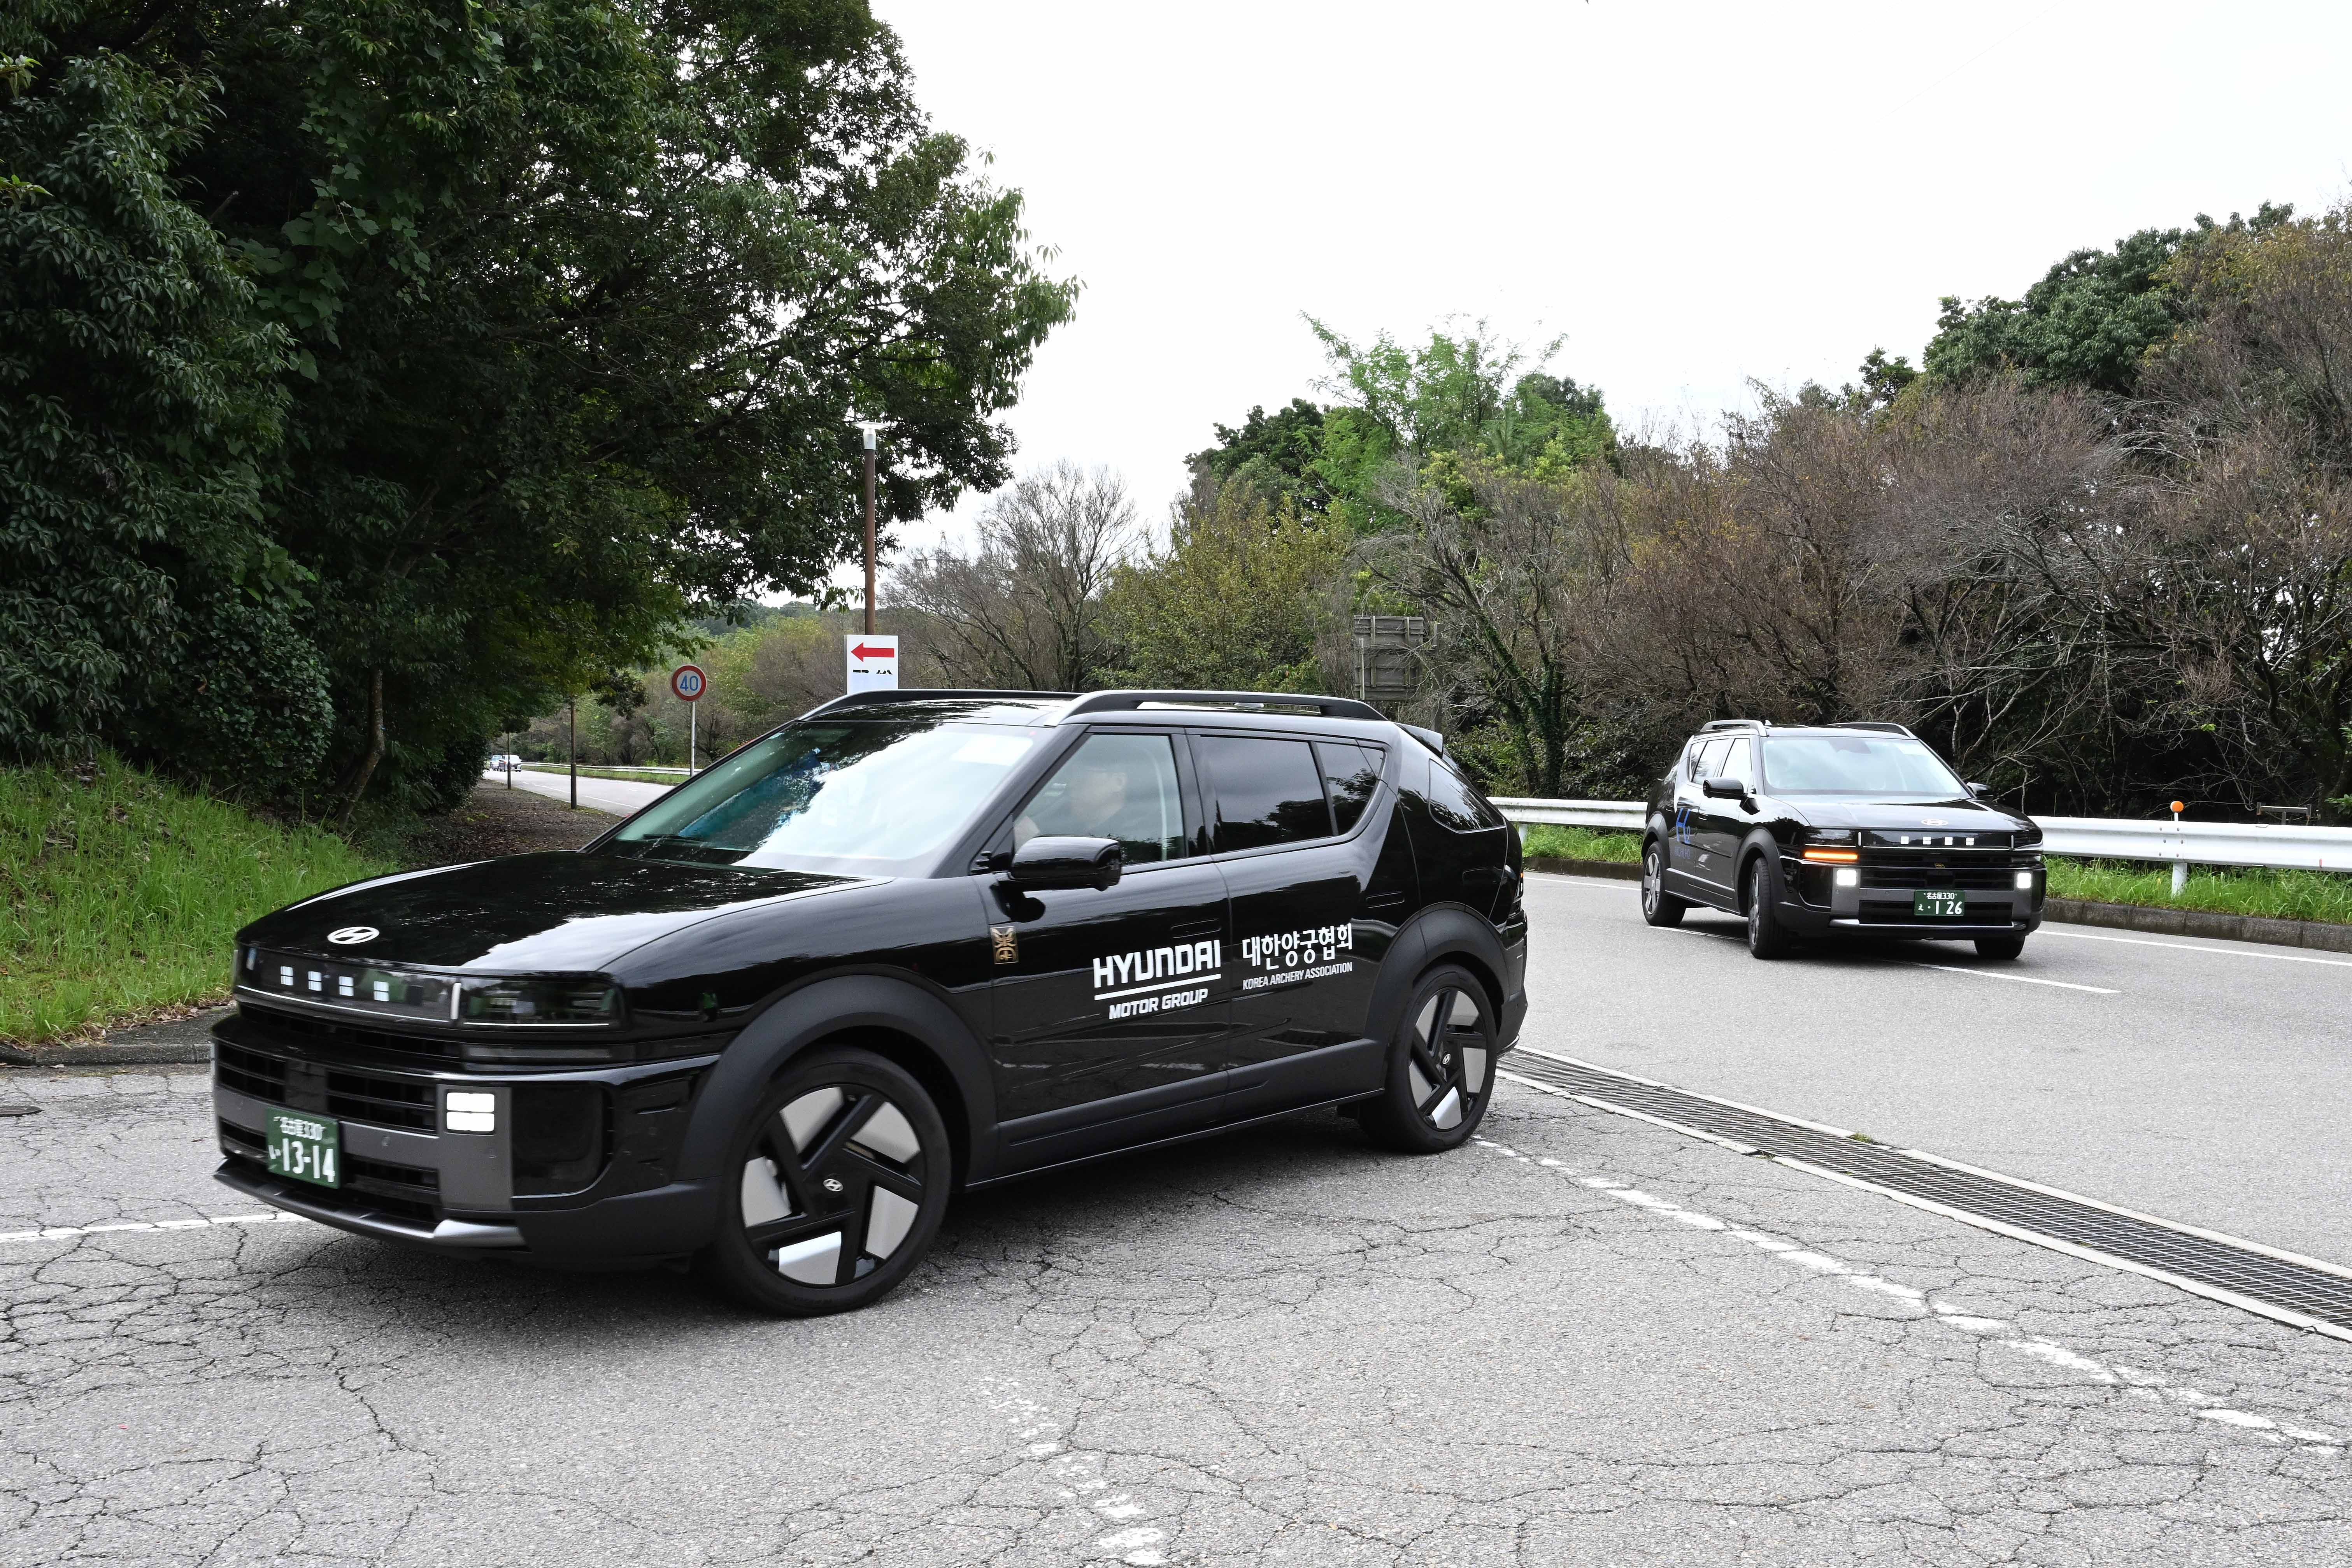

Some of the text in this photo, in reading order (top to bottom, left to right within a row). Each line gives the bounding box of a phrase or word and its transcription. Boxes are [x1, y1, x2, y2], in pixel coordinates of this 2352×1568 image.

[680, 675, 698, 691] 40
[1093, 940, 1221, 988] HYUNDAI
[1242, 923, 1352, 970] 대한양궁협회
[1242, 961, 1353, 990] KOREA ARCHERY ASSOCIATION
[1109, 988, 1208, 1019] MOTOR GROUP
[282, 1138, 335, 1182] 13-14
